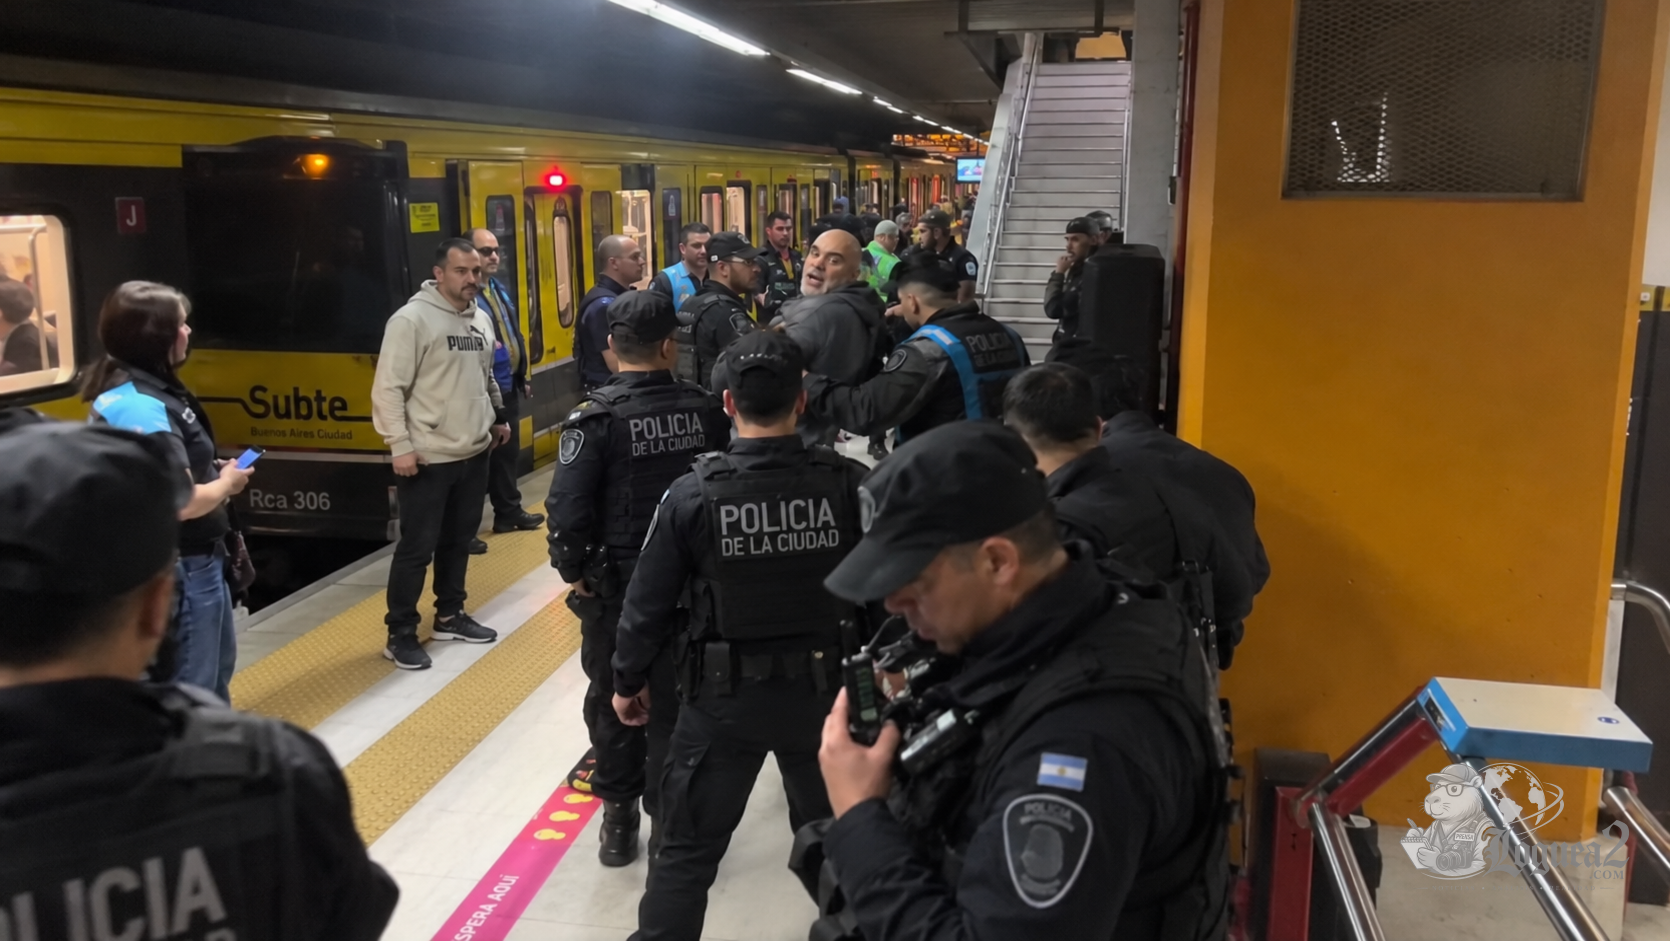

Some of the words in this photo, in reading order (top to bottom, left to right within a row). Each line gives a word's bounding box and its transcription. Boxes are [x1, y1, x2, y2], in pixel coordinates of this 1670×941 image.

[125, 204, 137, 227] J
[447, 335, 484, 351] PUMA
[249, 385, 348, 422] Subte
[250, 426, 287, 438] Buenos
[289, 428, 315, 439] Aires
[317, 429, 353, 440] Ciudad
[629, 412, 703, 441] POLICIA
[632, 442, 648, 456] DE
[650, 440, 666, 454] LA
[668, 434, 706, 451] CIUDAD
[249, 489, 288, 509] Rca
[293, 491, 331, 510] 306
[720, 498, 836, 535] POLICIA
[722, 537, 745, 556] DE
[750, 535, 773, 555] LA
[777, 529, 839, 552] CIUDAD
[451, 904, 498, 941] SPERA
[487, 874, 520, 902] AQUÍ
